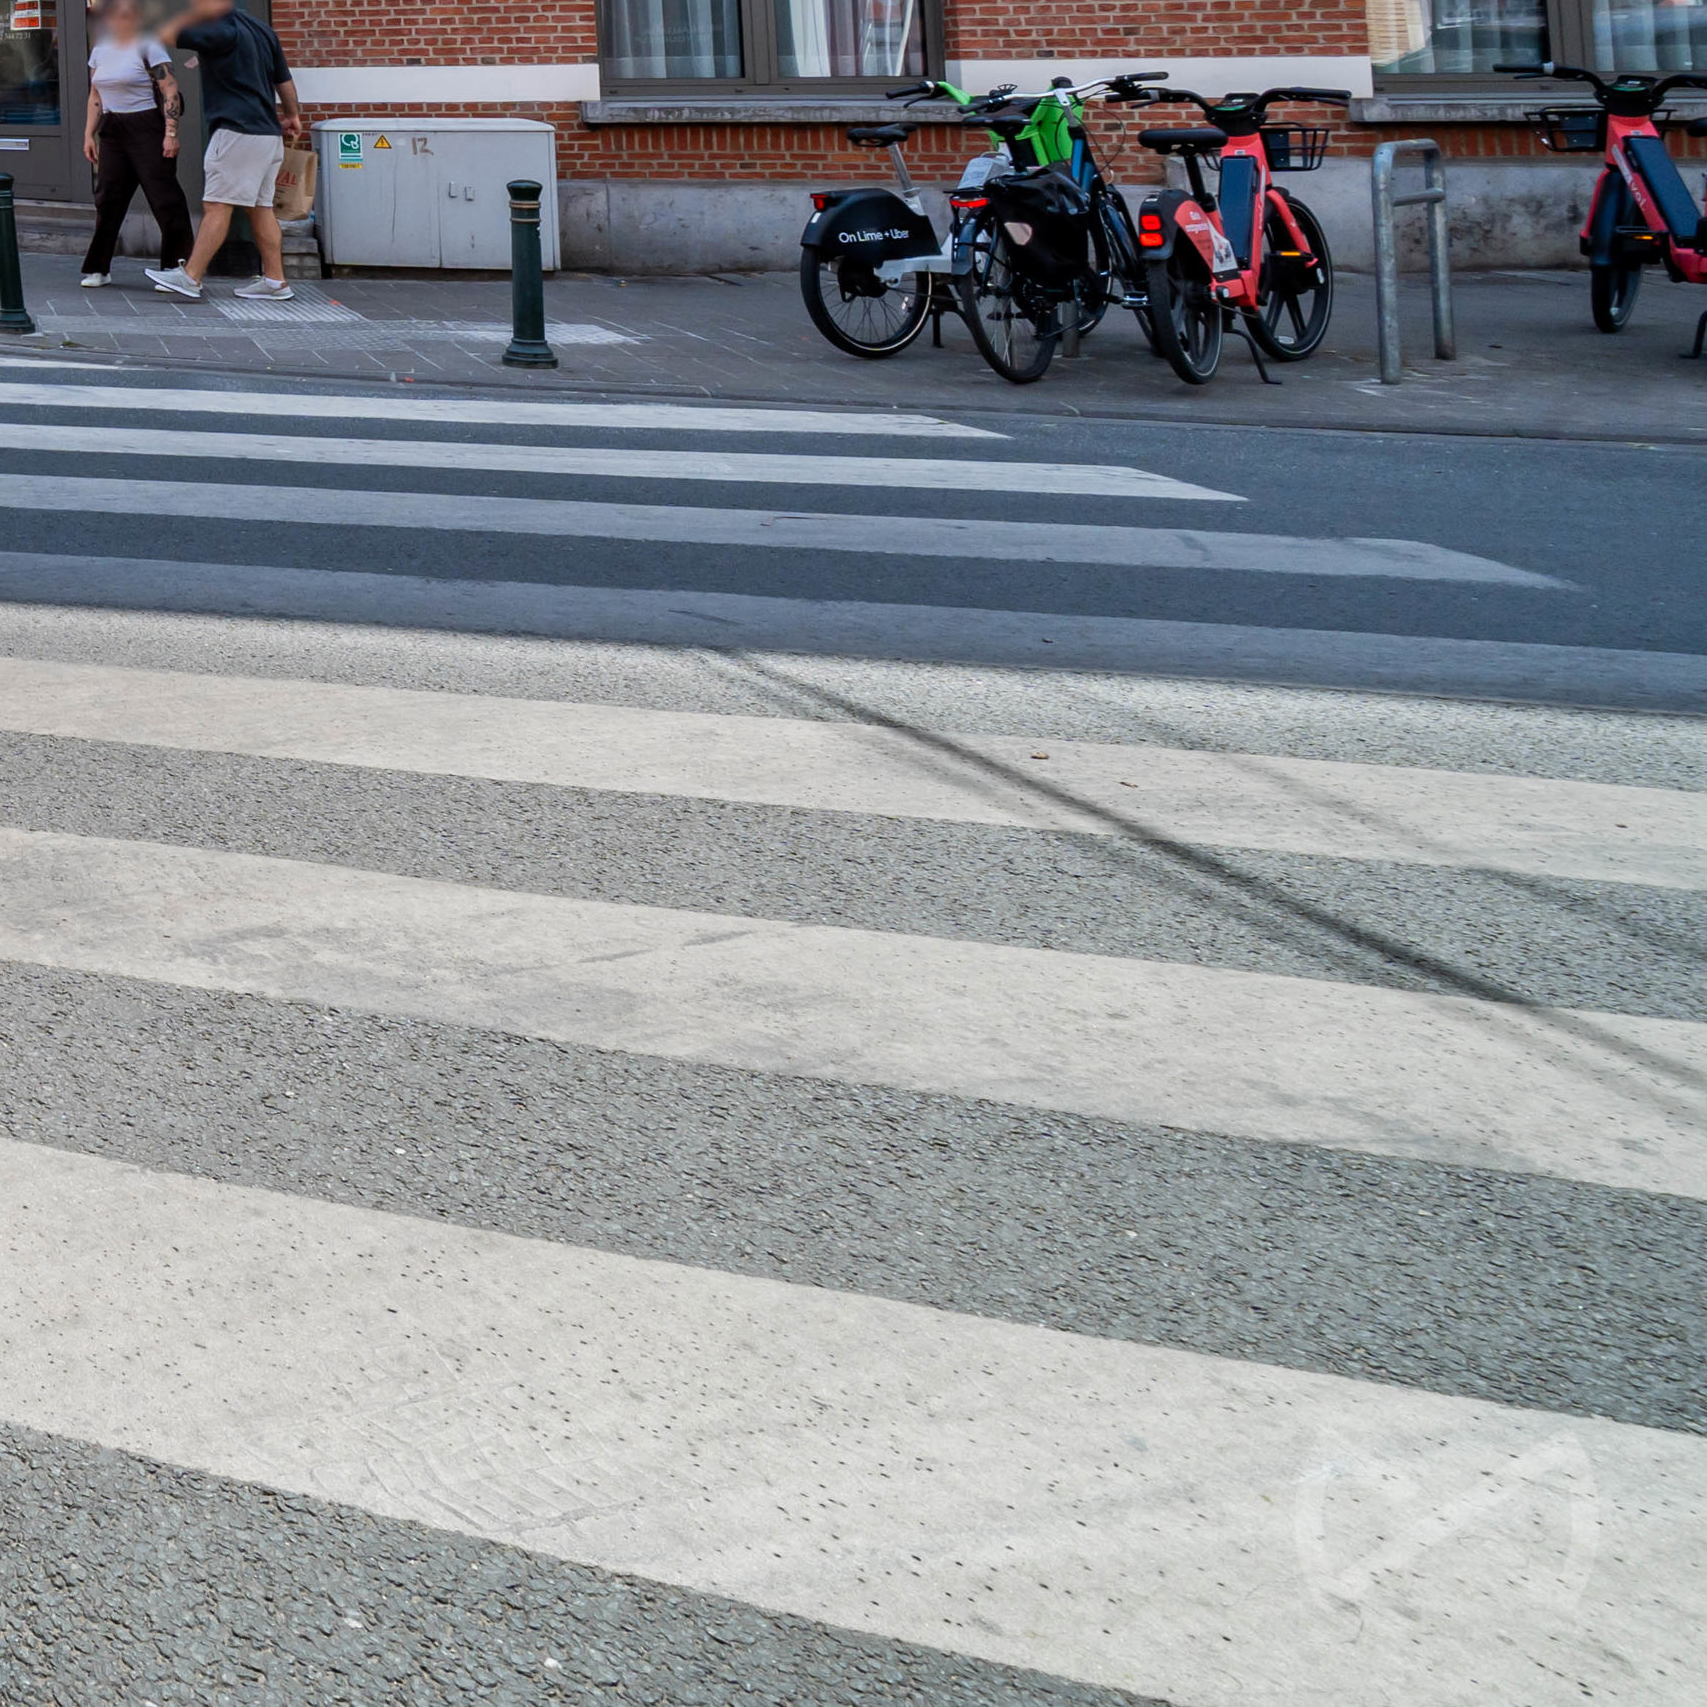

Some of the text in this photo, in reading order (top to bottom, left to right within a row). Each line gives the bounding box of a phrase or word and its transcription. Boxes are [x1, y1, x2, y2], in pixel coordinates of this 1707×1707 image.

[839, 232, 857, 243] On
[857, 230, 883, 242] Lime
[890, 228, 909, 239] Uber
